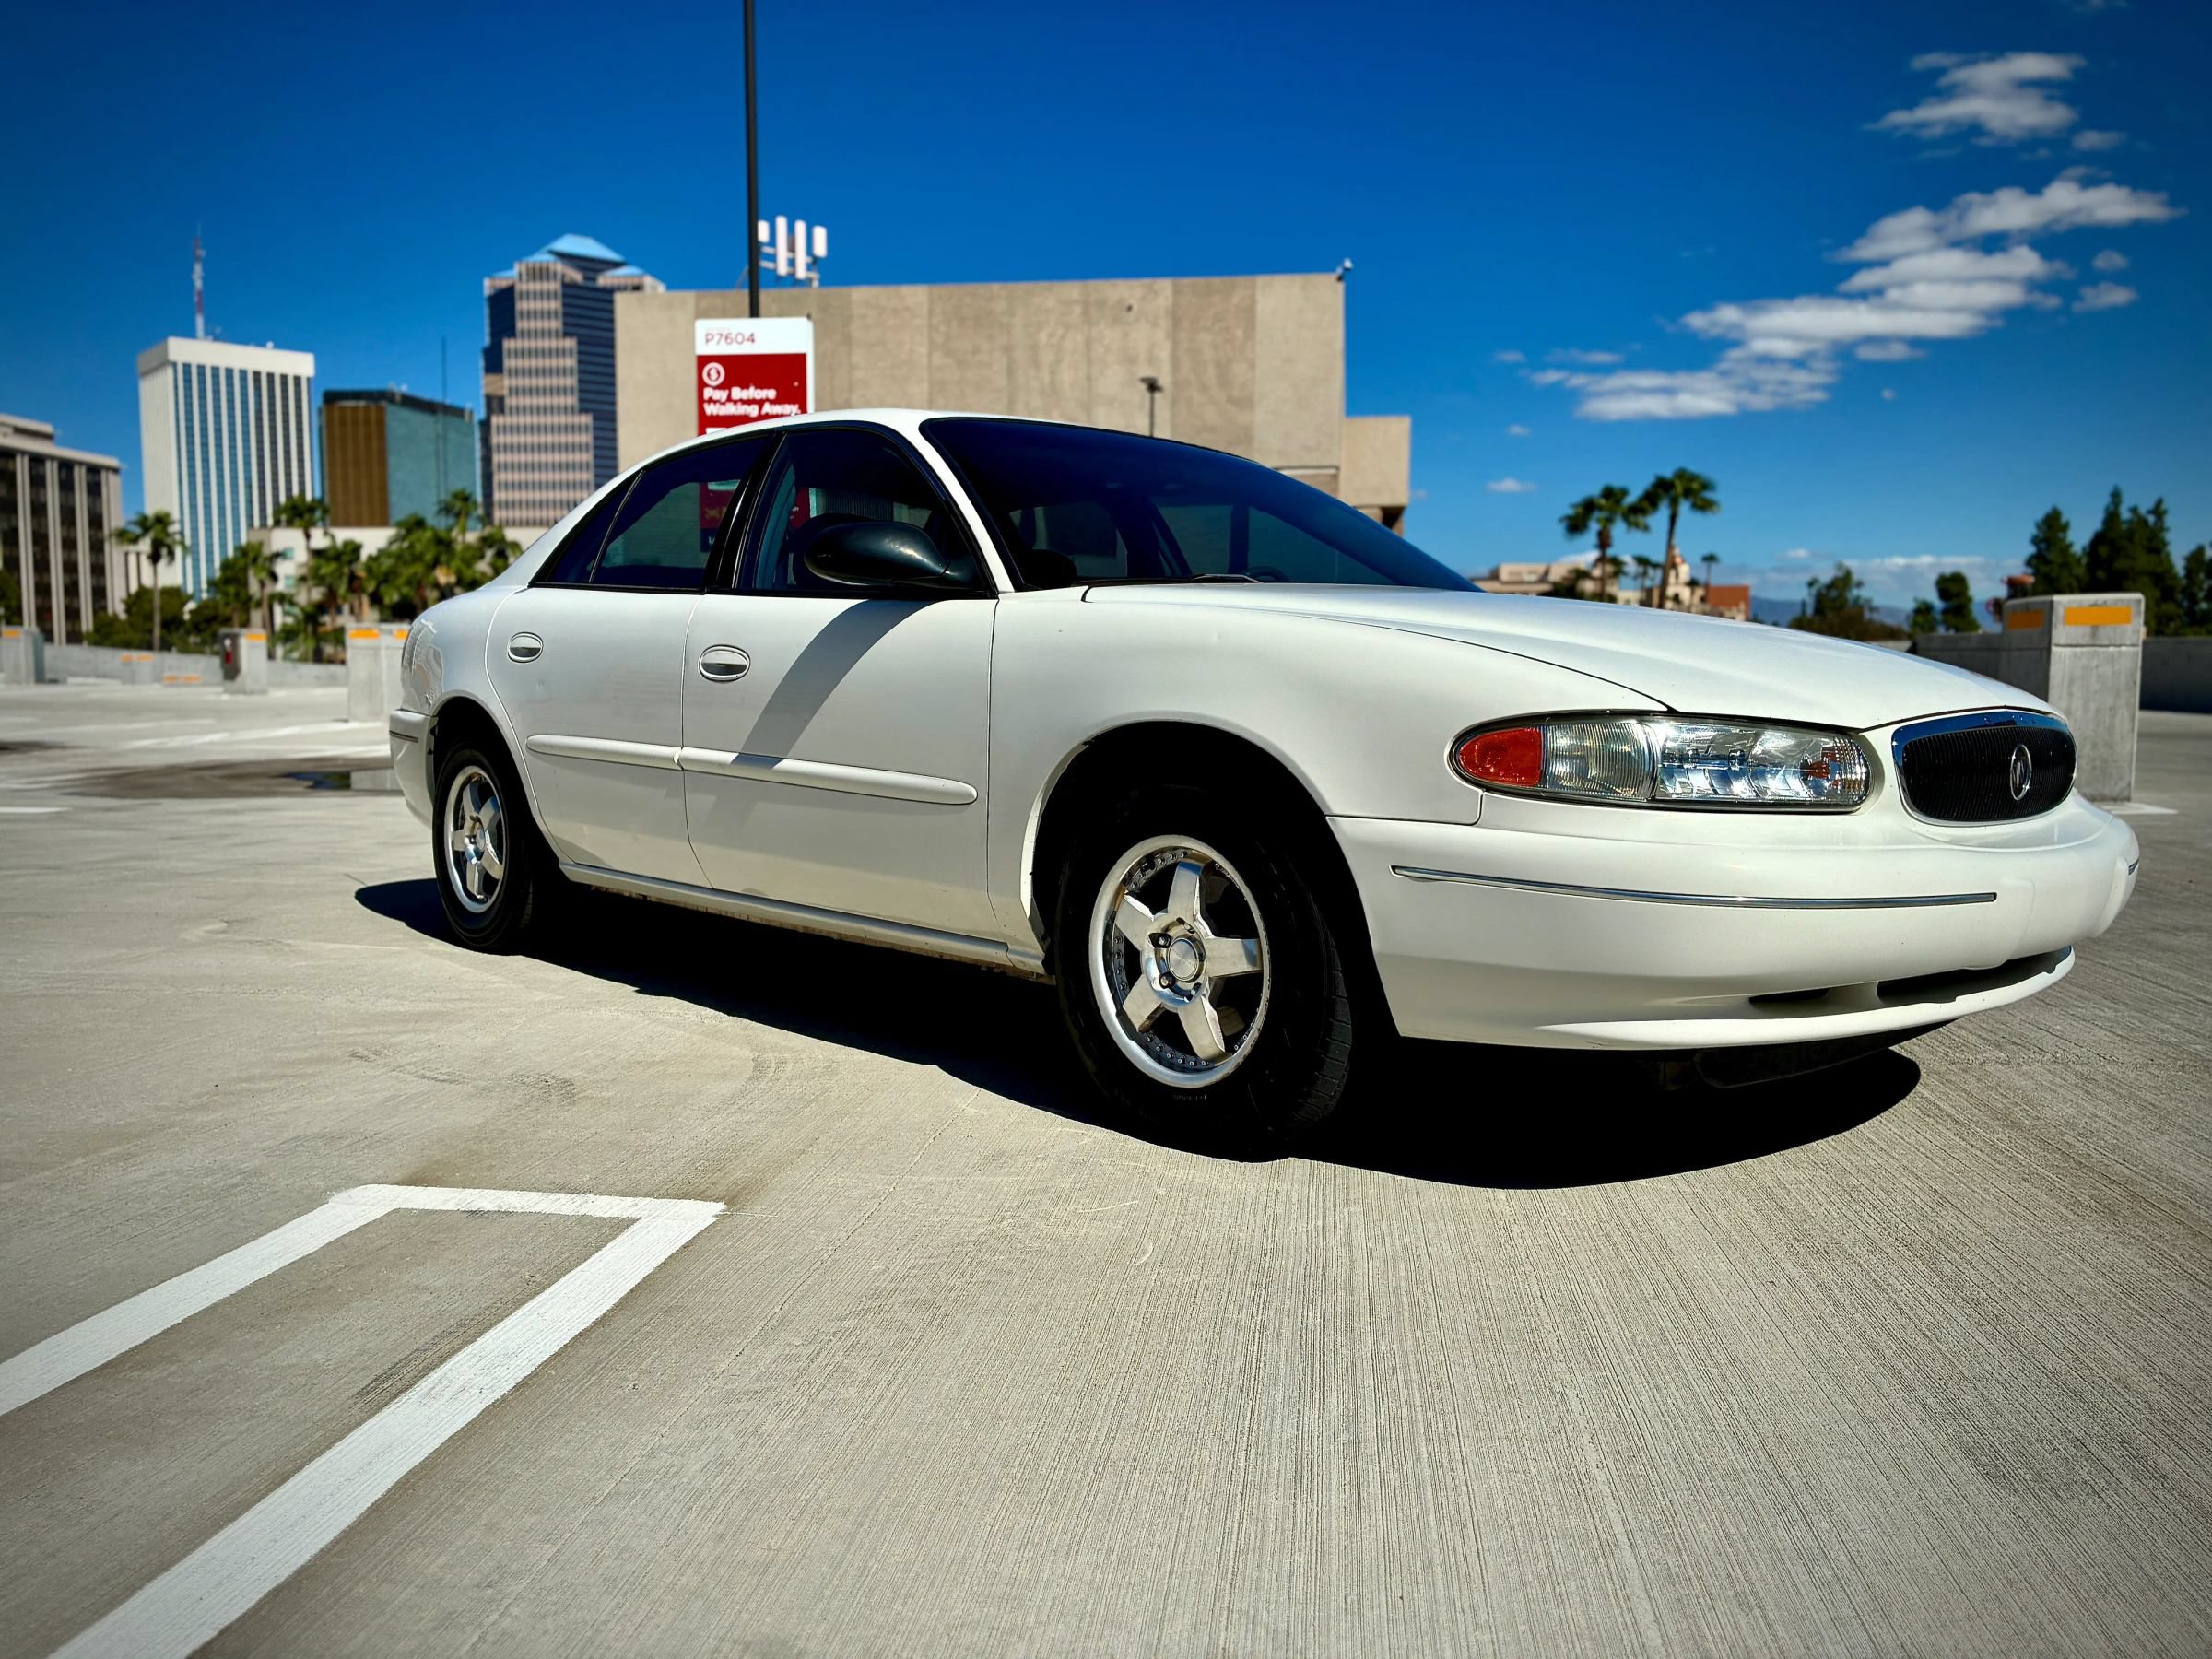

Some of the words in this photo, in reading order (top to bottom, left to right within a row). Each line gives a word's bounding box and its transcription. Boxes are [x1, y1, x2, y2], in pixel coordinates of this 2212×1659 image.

[705, 332, 756, 346] P7604
[703, 387, 730, 403] Pay
[731, 385, 777, 401] Before
[703, 402, 759, 418] Walking
[760, 401, 802, 417] Away.
